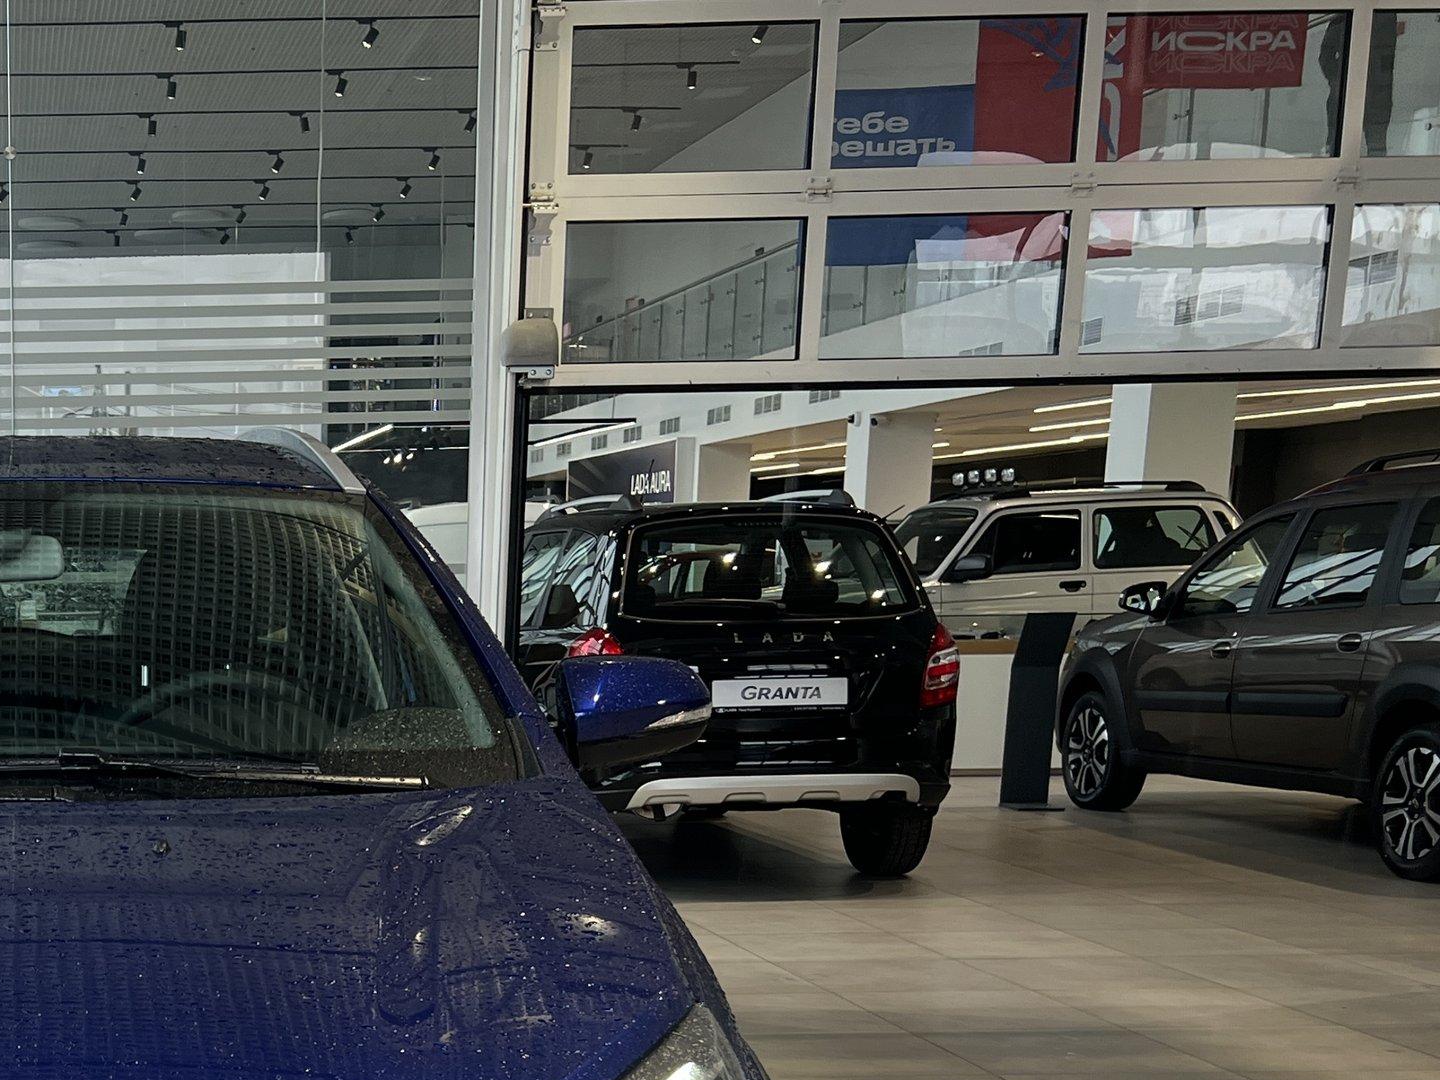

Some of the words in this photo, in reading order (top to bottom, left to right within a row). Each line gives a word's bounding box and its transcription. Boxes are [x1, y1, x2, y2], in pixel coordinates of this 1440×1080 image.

[1151, 30, 1297, 51] ИСКРА
[1149, 52, 1295, 73] ИСКРА
[834, 110, 909, 135] ебе
[630, 474, 650, 495] LADA
[650, 470, 671, 493] AURA
[733, 631, 835, 643] LADA
[740, 685, 822, 700] GRANTA
